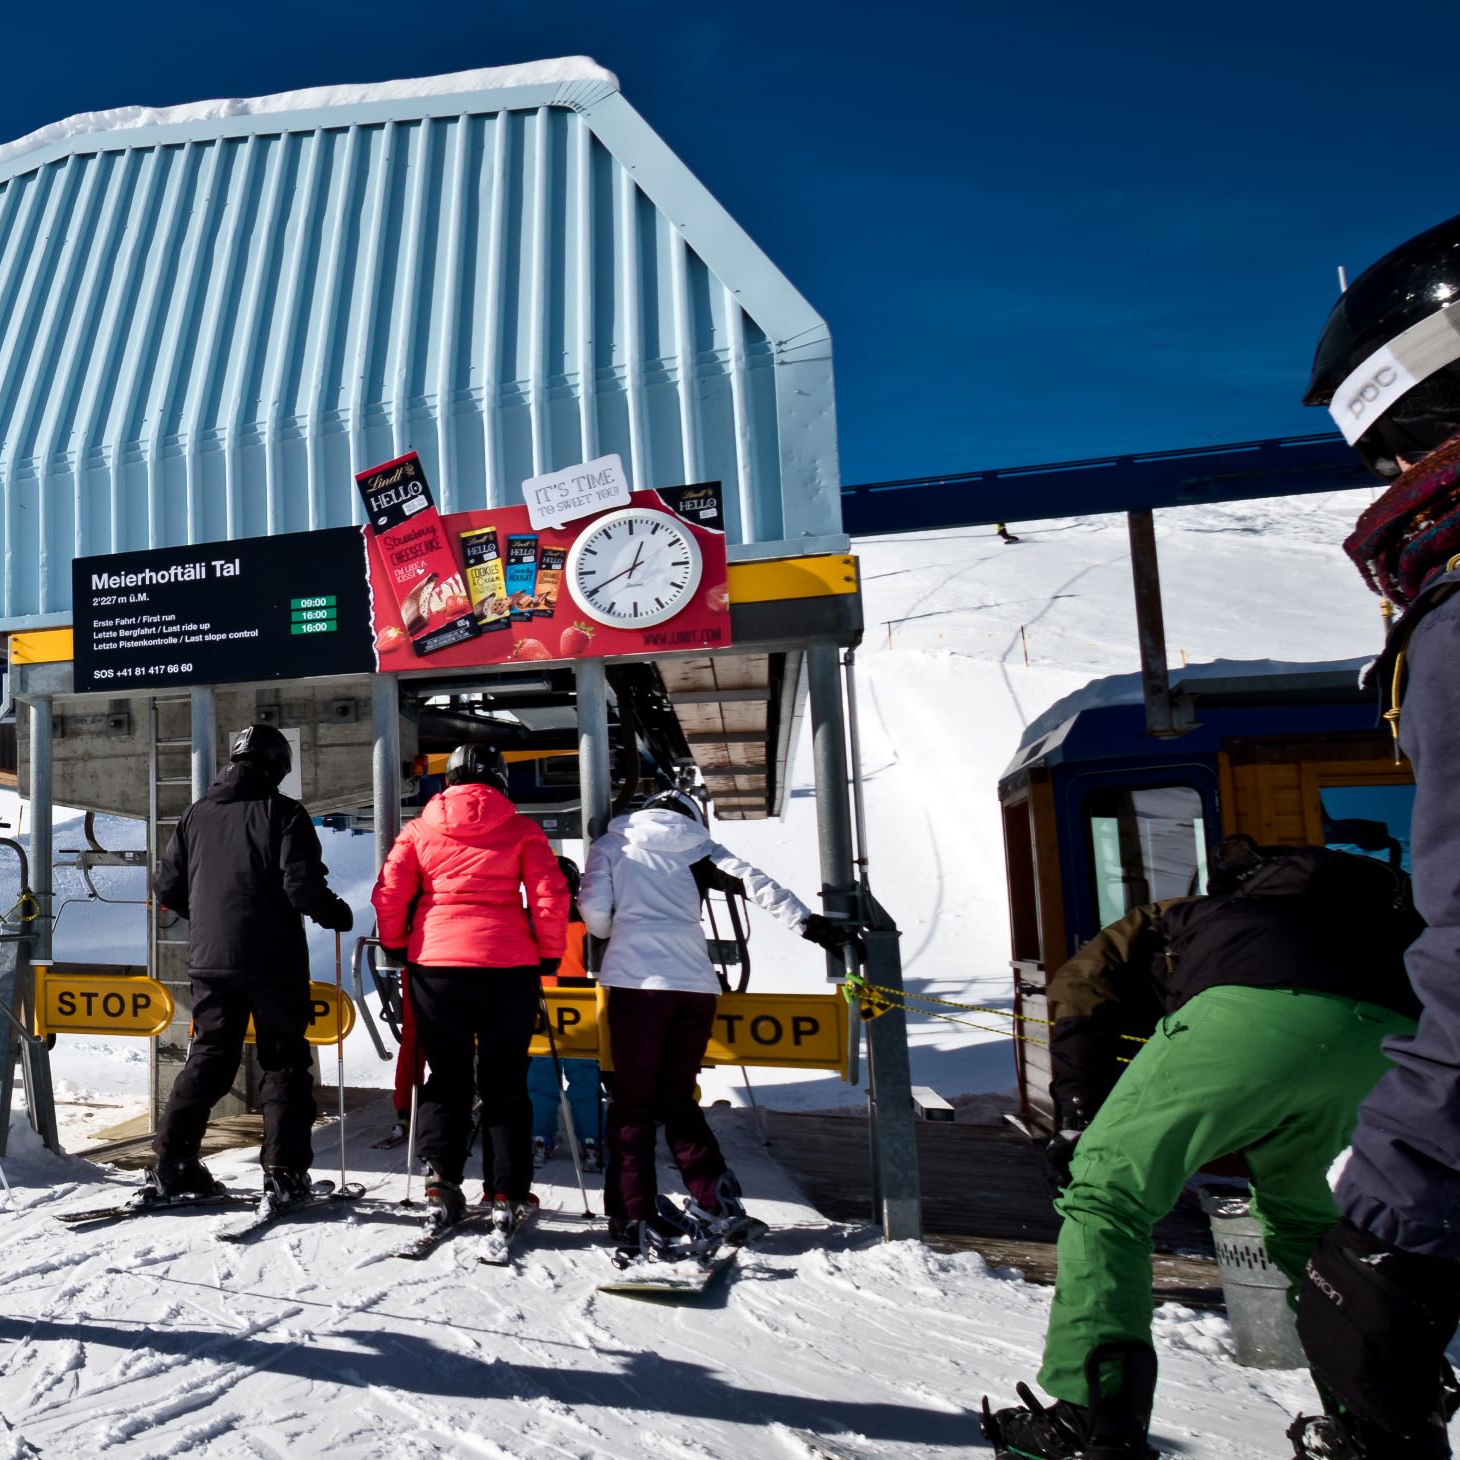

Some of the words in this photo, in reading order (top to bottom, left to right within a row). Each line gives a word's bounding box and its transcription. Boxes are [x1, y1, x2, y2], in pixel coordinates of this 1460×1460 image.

[1348, 366, 1397, 420] POC
[366, 467, 404, 493] Lindt
[534, 482, 570, 505] IT'S
[571, 468, 615, 493] TIME
[370, 481, 423, 512] HELLO
[537, 504, 555, 517] TO
[557, 493, 593, 512] SWEET
[679, 497, 717, 512] HELLO
[390, 536, 443, 567] CHEESECAKE
[467, 543, 496, 556] HELLO
[511, 548, 535, 556] HELLO
[91, 562, 206, 590] Meierhoftäli
[211, 558, 240, 578] Tal
[129, 592, 150, 603] ü.M.
[301, 597, 327, 608] 09:00
[93, 619, 114, 628] Erste
[115, 616, 136, 626] Fahrt
[142, 614, 160, 623] First
[302, 609, 327, 620] 16:00
[93, 631, 118, 639] Letzte
[119, 627, 156, 637] Bergfahrt
[162, 624, 181, 633] Last
[181, 622, 198, 631] ride
[199, 622, 211, 631] up
[302, 622, 327, 633] 16:00
[93, 642, 118, 651] Letzte
[119, 636, 178, 649] Pistenkontrolle
[184, 634, 203, 643] Last
[204, 633, 227, 642] slope
[228, 629, 259, 639] control
[93, 669, 114, 679] SOS
[116, 667, 132, 678] +41
[134, 666, 146, 676] 81
[148, 665, 166, 675] 417
[167, 664, 179, 674] 66
[180, 663, 193, 673] 60
[57, 991, 152, 1018] STOP
[717, 1014, 820, 1047] TOP
